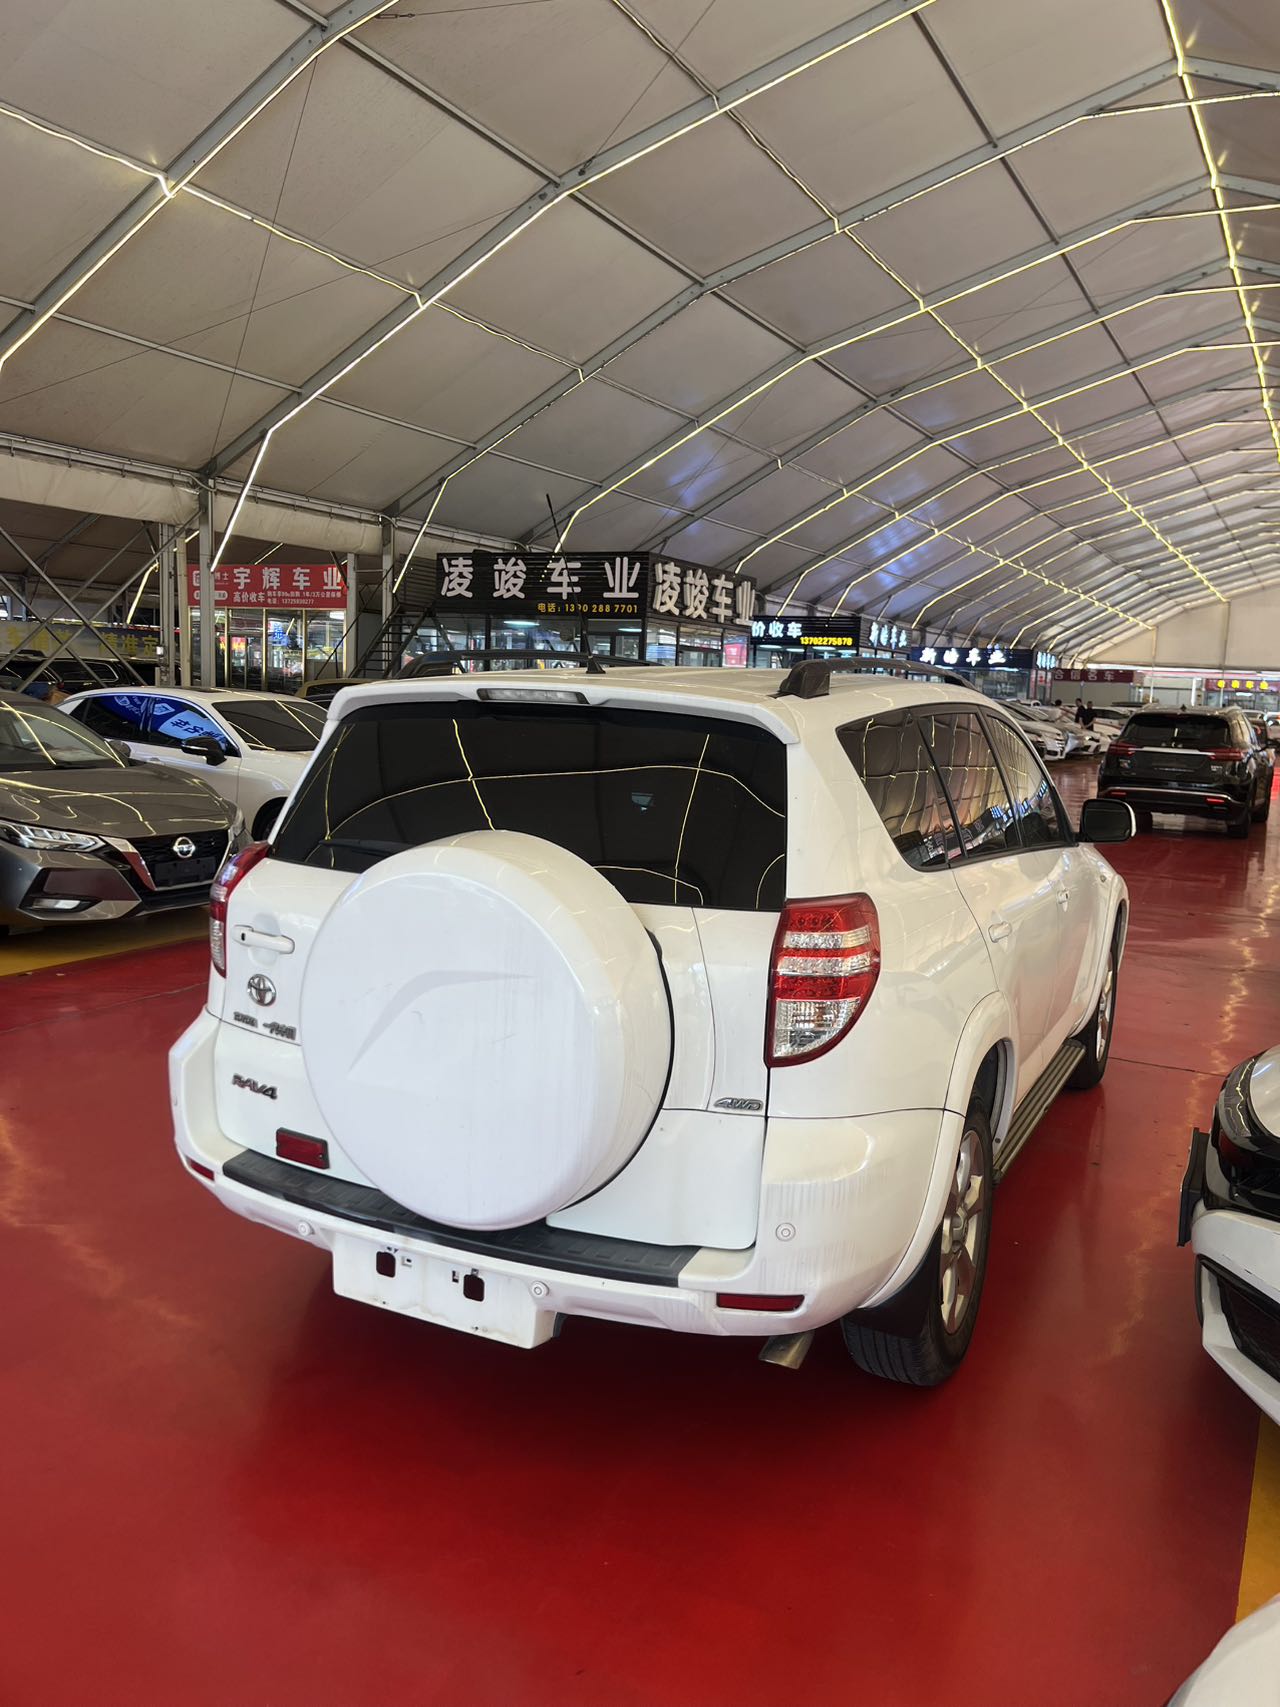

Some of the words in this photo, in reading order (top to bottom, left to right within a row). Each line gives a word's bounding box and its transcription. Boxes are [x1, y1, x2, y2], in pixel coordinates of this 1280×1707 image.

[233, 567, 342, 590] 宇辉车业
[440, 556, 641, 600] 凌竣车业
[233, 591, 265, 603] 高价收车
[653, 561, 755, 627] 凌竣车业
[592, 604, 611, 613] 288
[614, 604, 639, 614] 7701
[231, 1072, 278, 1101] RAV4
